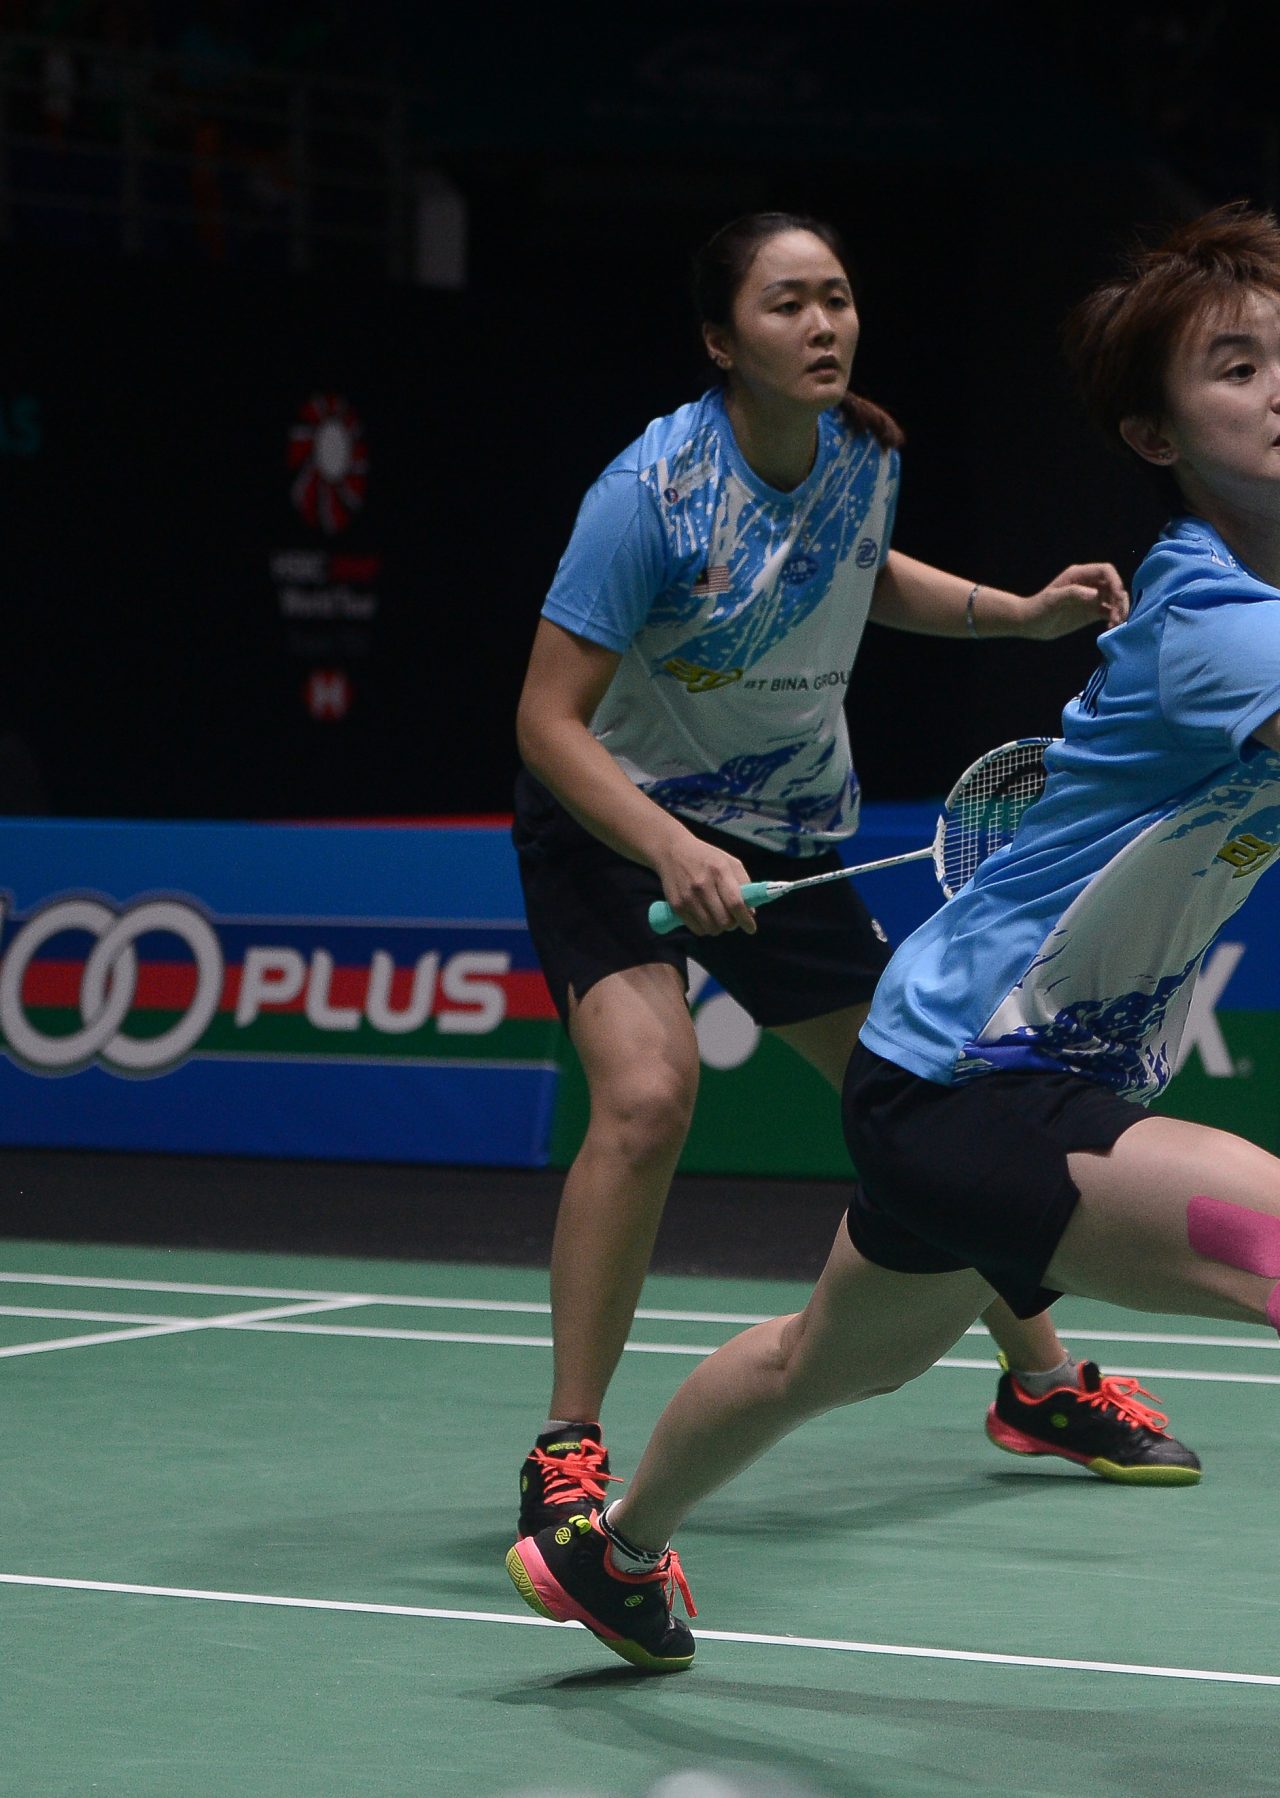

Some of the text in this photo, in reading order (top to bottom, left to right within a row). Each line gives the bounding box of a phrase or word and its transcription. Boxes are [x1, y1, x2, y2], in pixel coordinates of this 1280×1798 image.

[771, 677, 809, 692] BINA
[814, 670, 849, 690] GROU
[0, 897, 511, 1068] 00 PLUS
